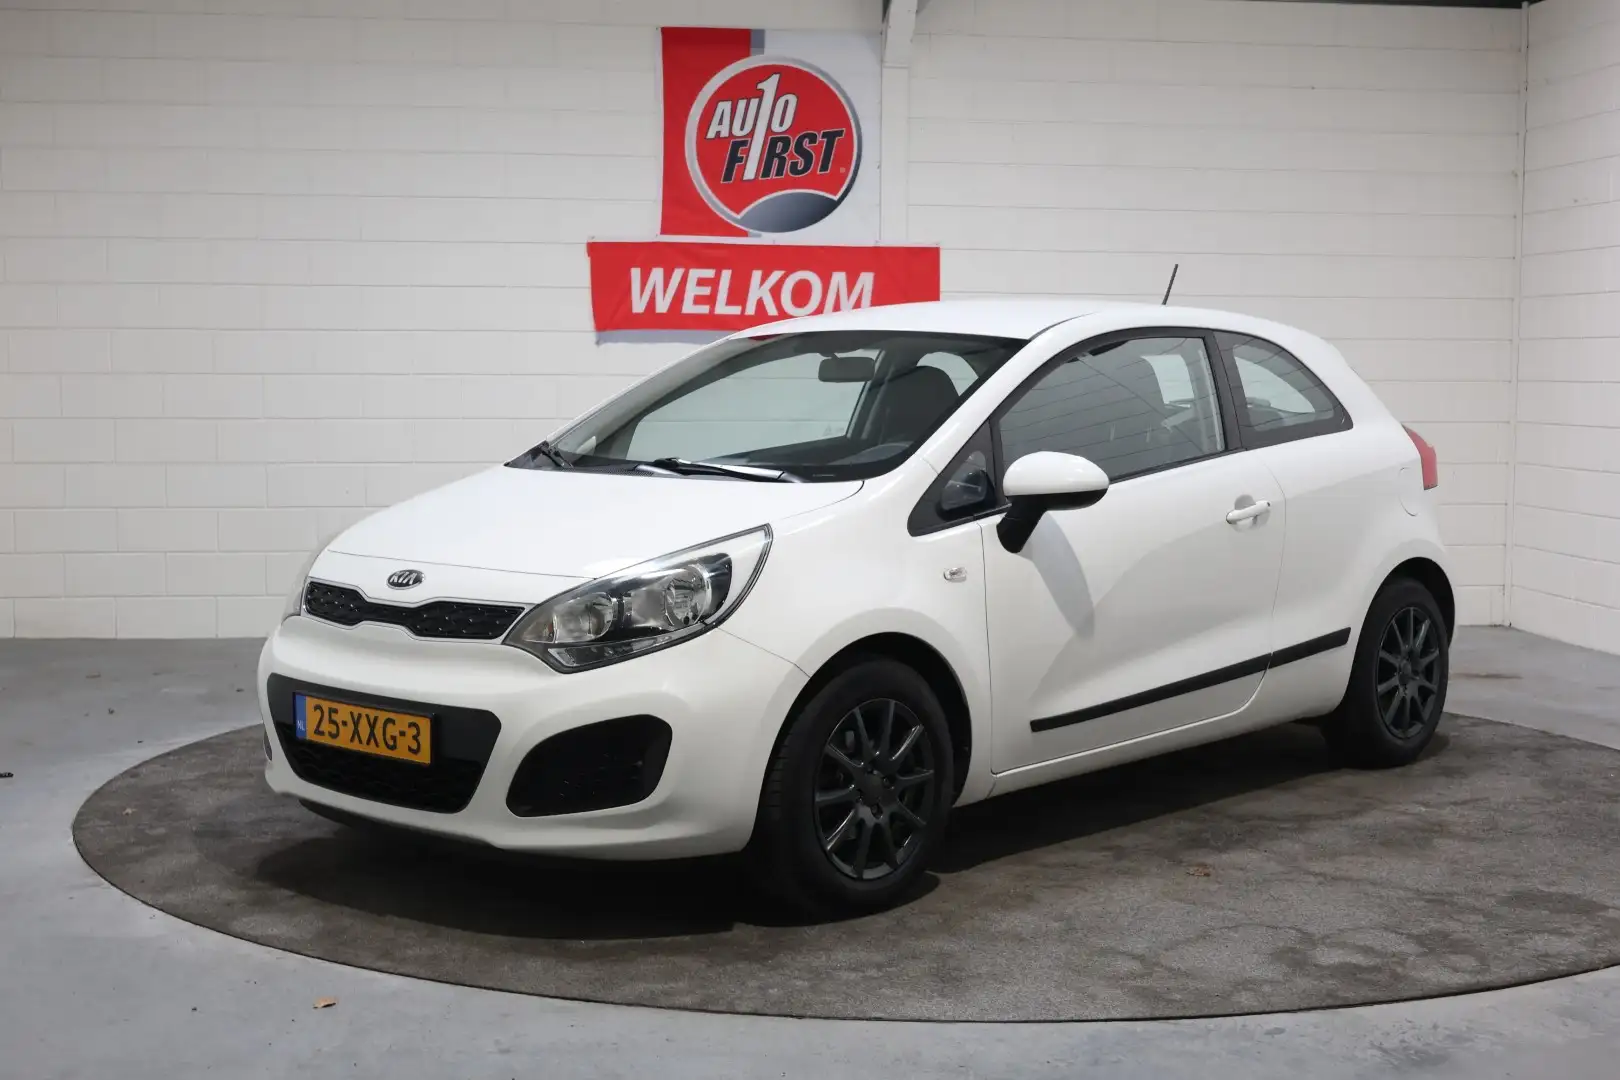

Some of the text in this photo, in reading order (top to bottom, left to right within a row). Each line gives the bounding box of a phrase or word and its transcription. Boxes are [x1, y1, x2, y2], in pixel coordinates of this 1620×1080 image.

[630, 267, 875, 317] WELKOM
[389, 570, 418, 585] KIA
[297, 719, 306, 731] NL
[313, 703, 422, 755] 25-XXG-3
